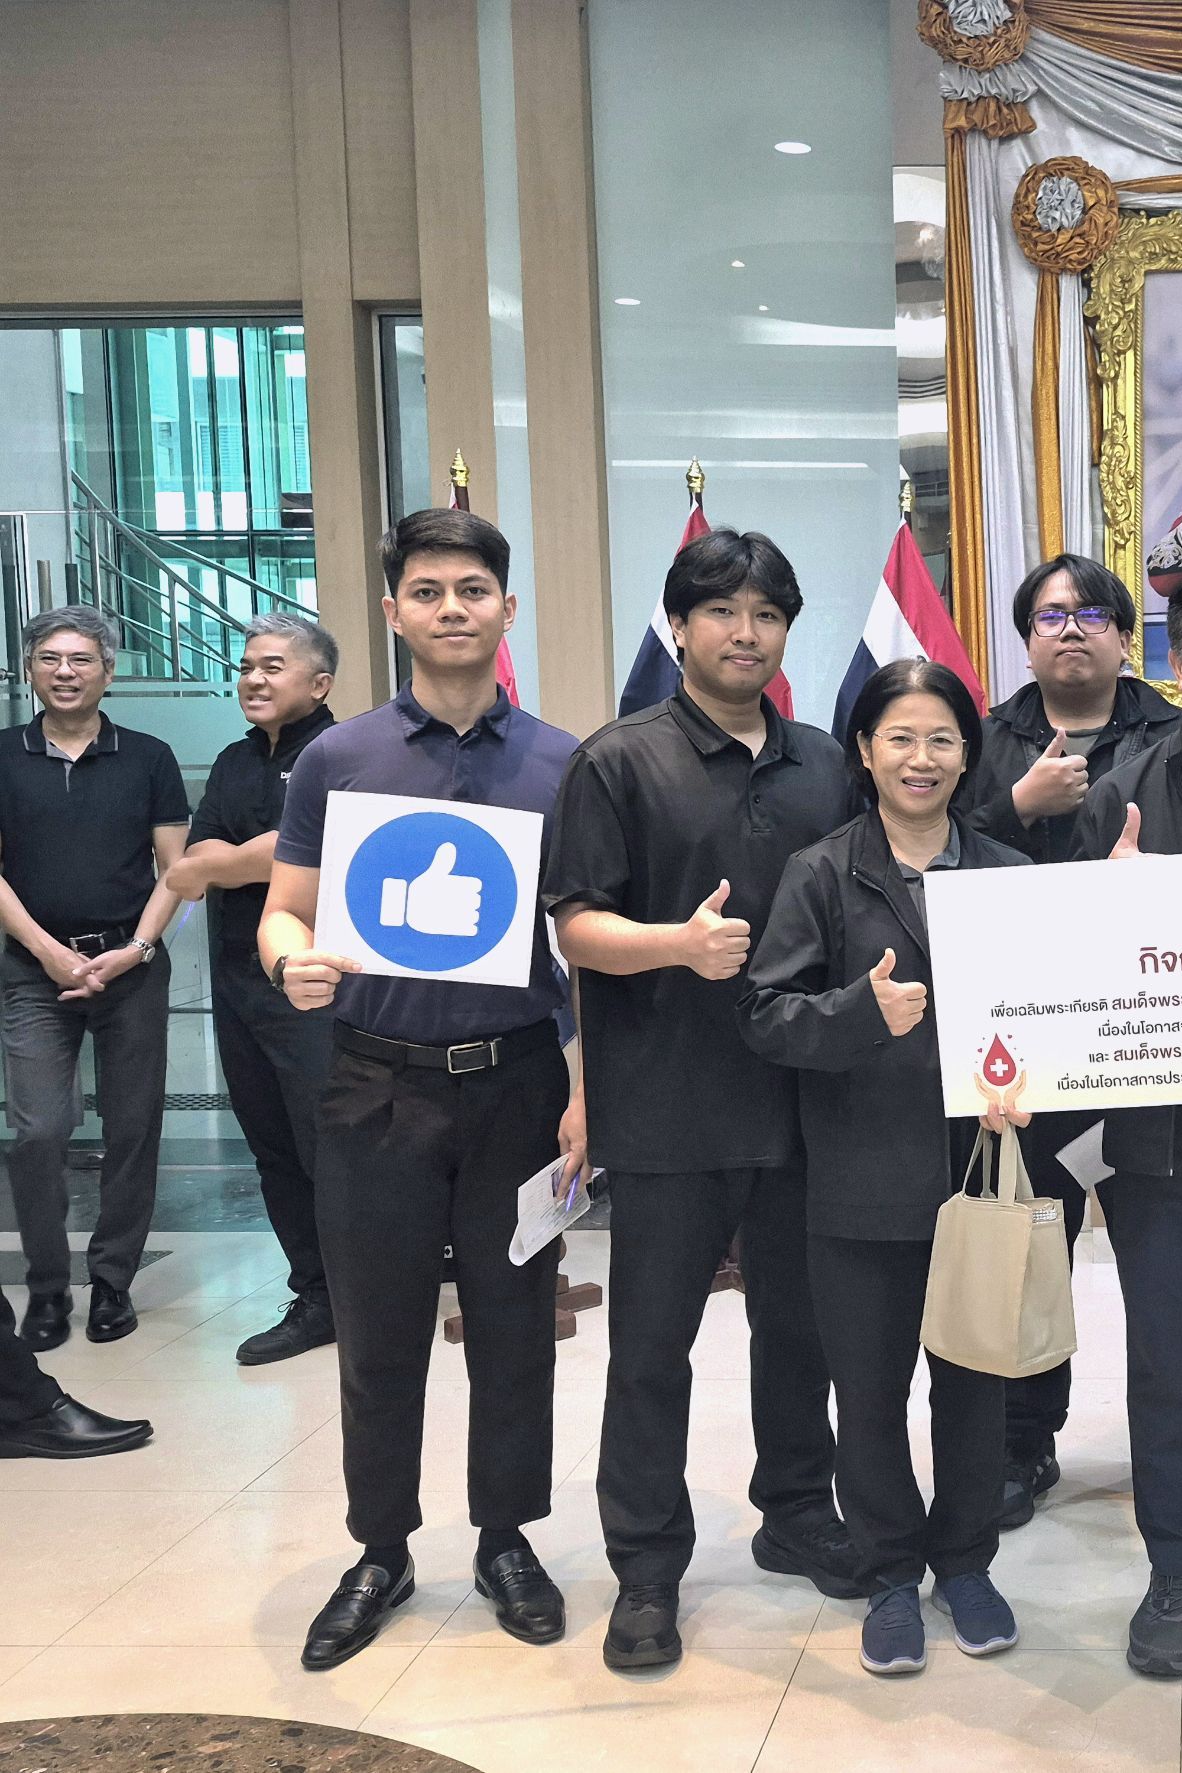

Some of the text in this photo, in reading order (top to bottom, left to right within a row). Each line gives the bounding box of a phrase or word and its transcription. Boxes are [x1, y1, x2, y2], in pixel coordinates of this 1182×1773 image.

[990, 999, 1109, 1018] เพื่อเฉลิมพระเกียรติ
[1089, 1052, 1110, 1064] และ
